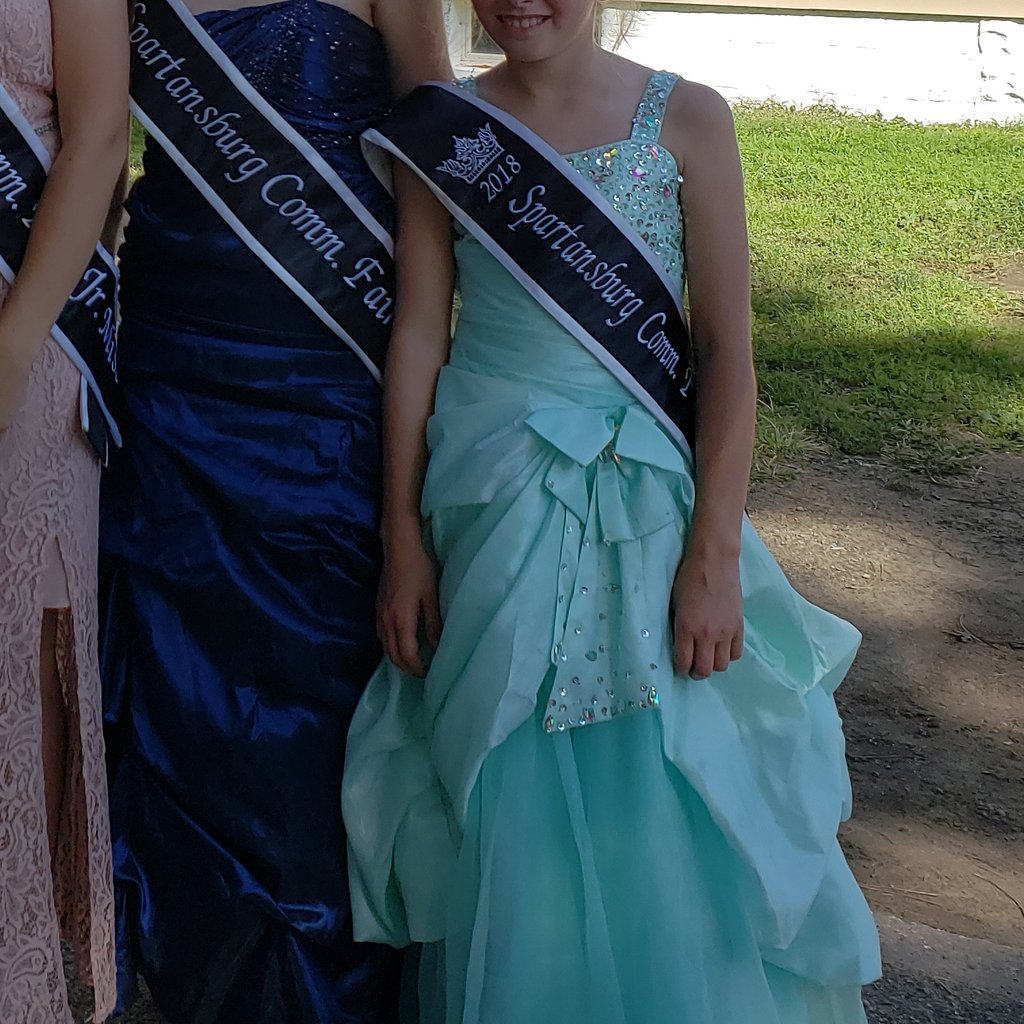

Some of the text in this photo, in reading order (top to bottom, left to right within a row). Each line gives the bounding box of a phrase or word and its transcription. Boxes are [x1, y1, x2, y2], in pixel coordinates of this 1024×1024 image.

[479, 154, 523, 203] 2018
[261, 173, 348, 269] Comm.
[69, 267, 108, 319] Jr.
[508, 184, 679, 380] Spartansburg Comm.
